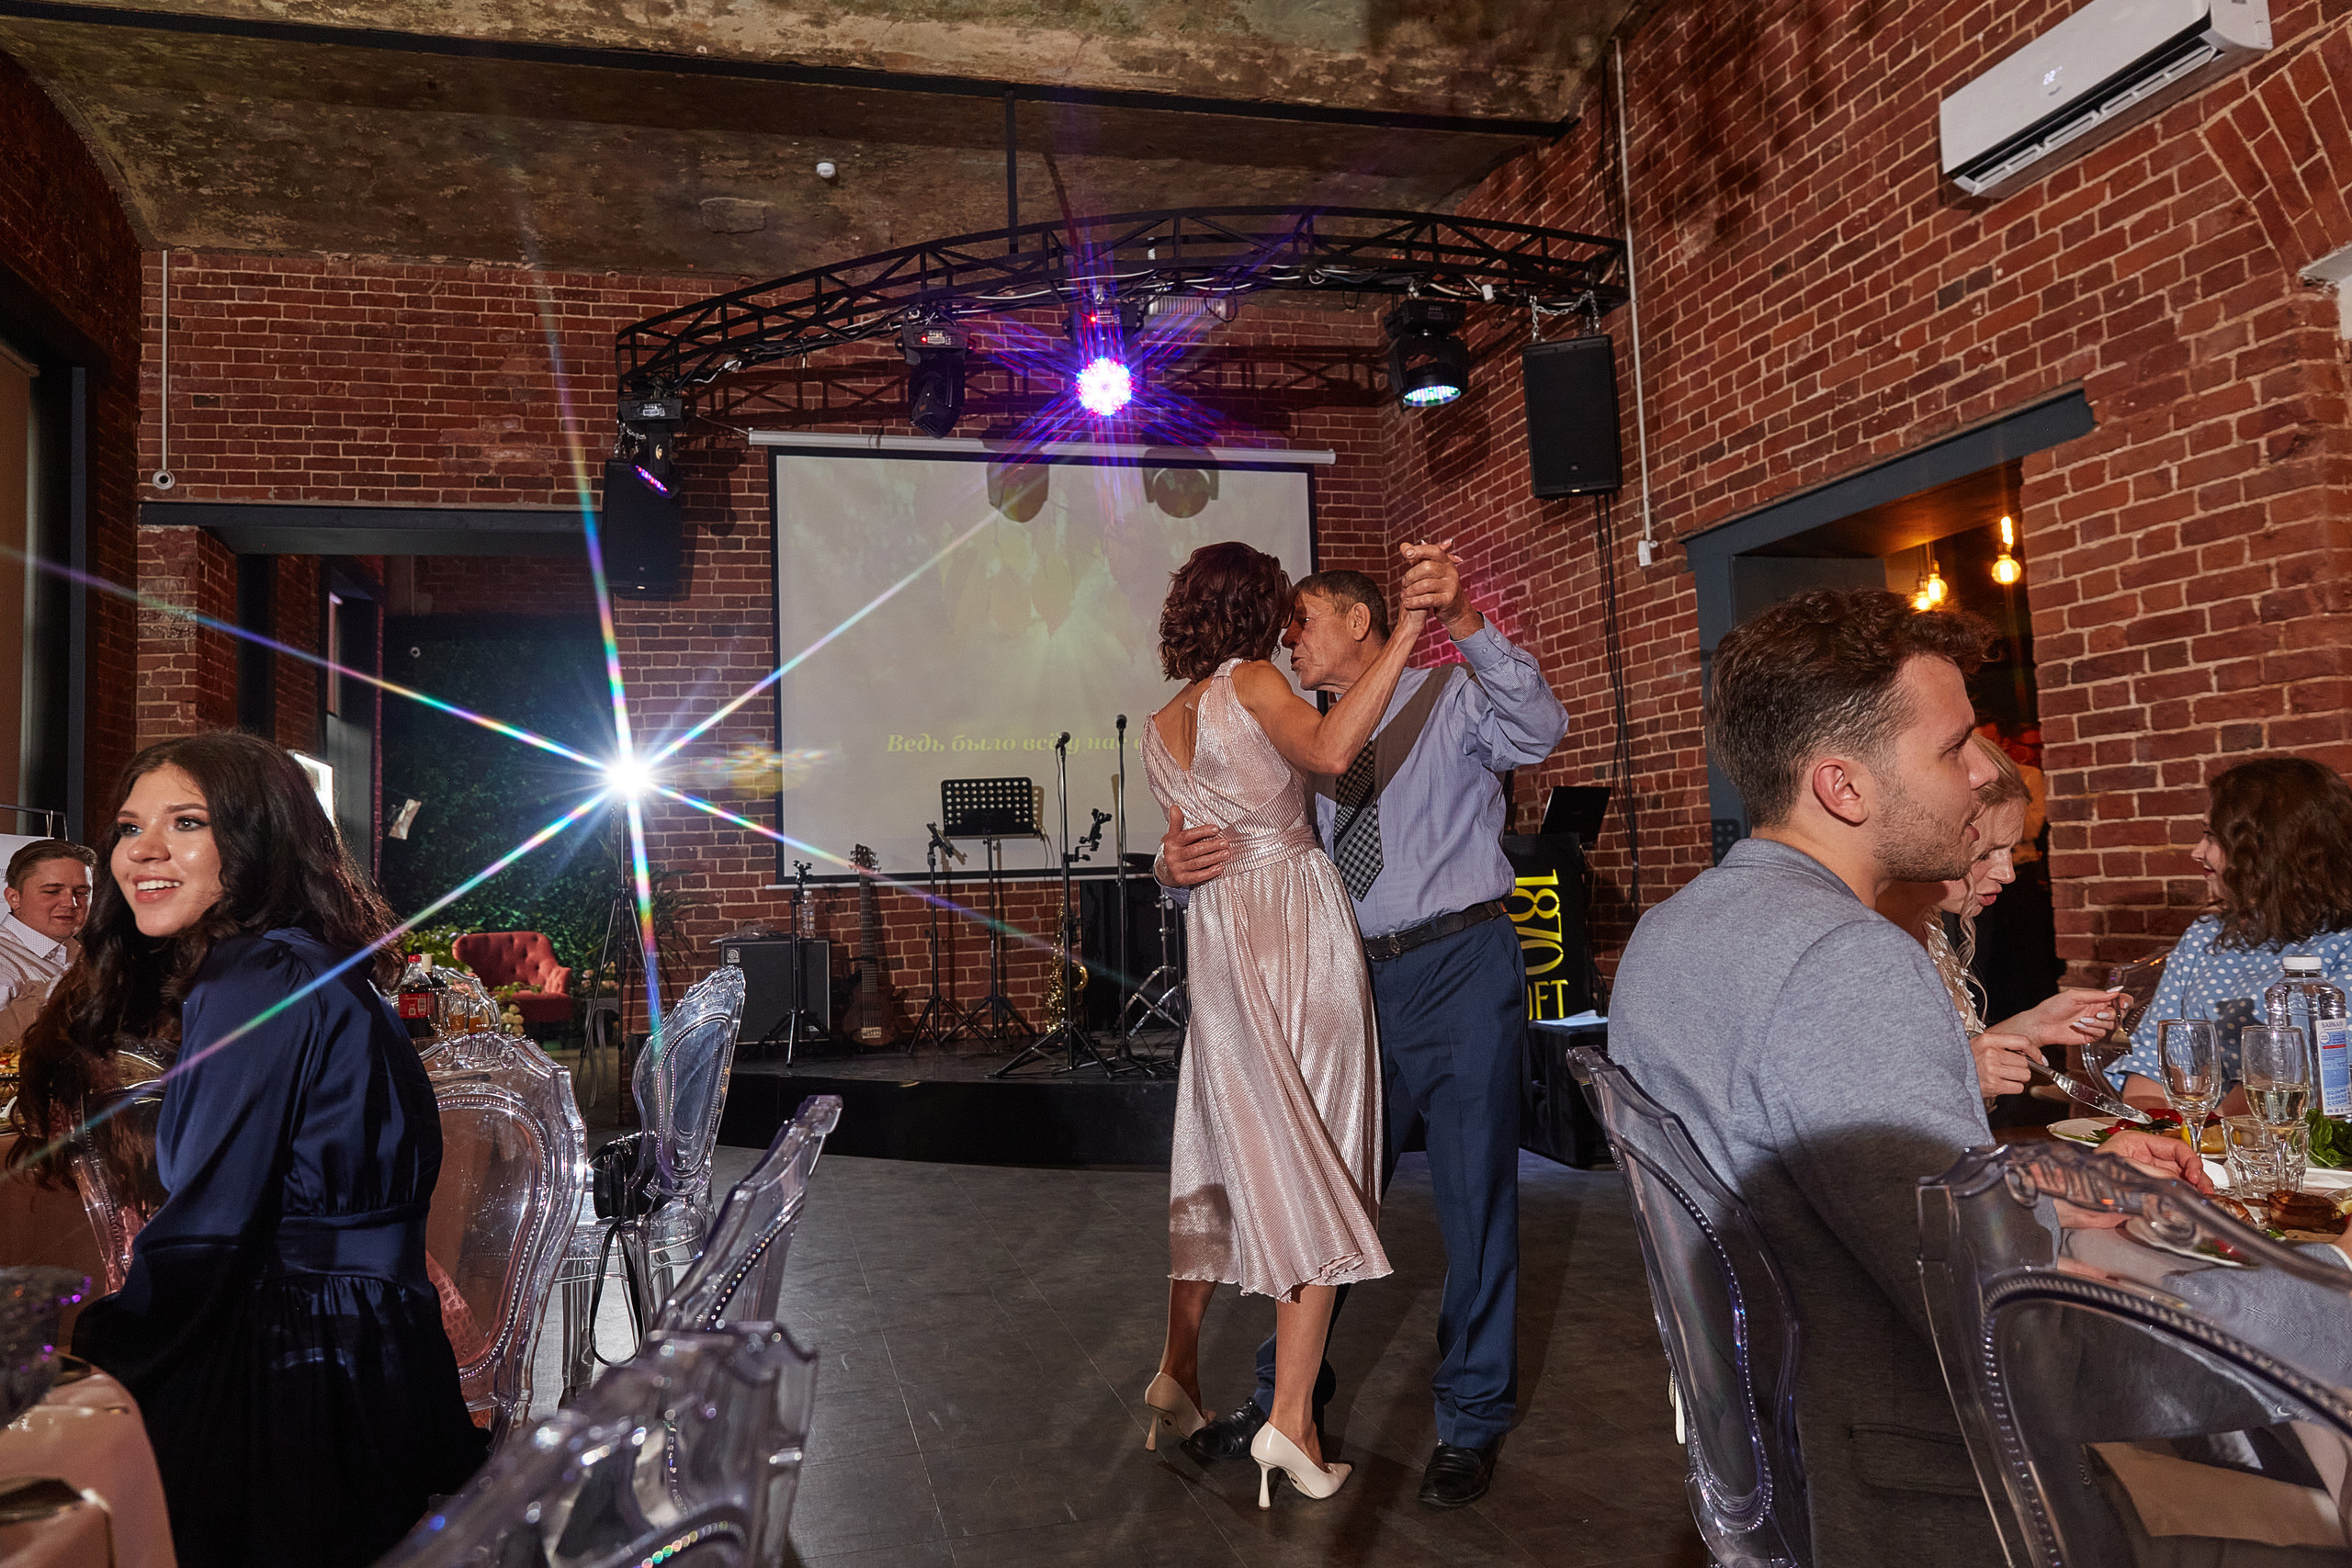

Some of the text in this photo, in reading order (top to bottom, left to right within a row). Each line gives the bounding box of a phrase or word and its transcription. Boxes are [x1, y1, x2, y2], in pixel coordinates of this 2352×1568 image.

[888, 733, 944, 751] Ведь
[951, 734, 1015, 750] было
[1510, 869, 1564, 976] 1870
[1528, 979, 1568, 1021] FT
